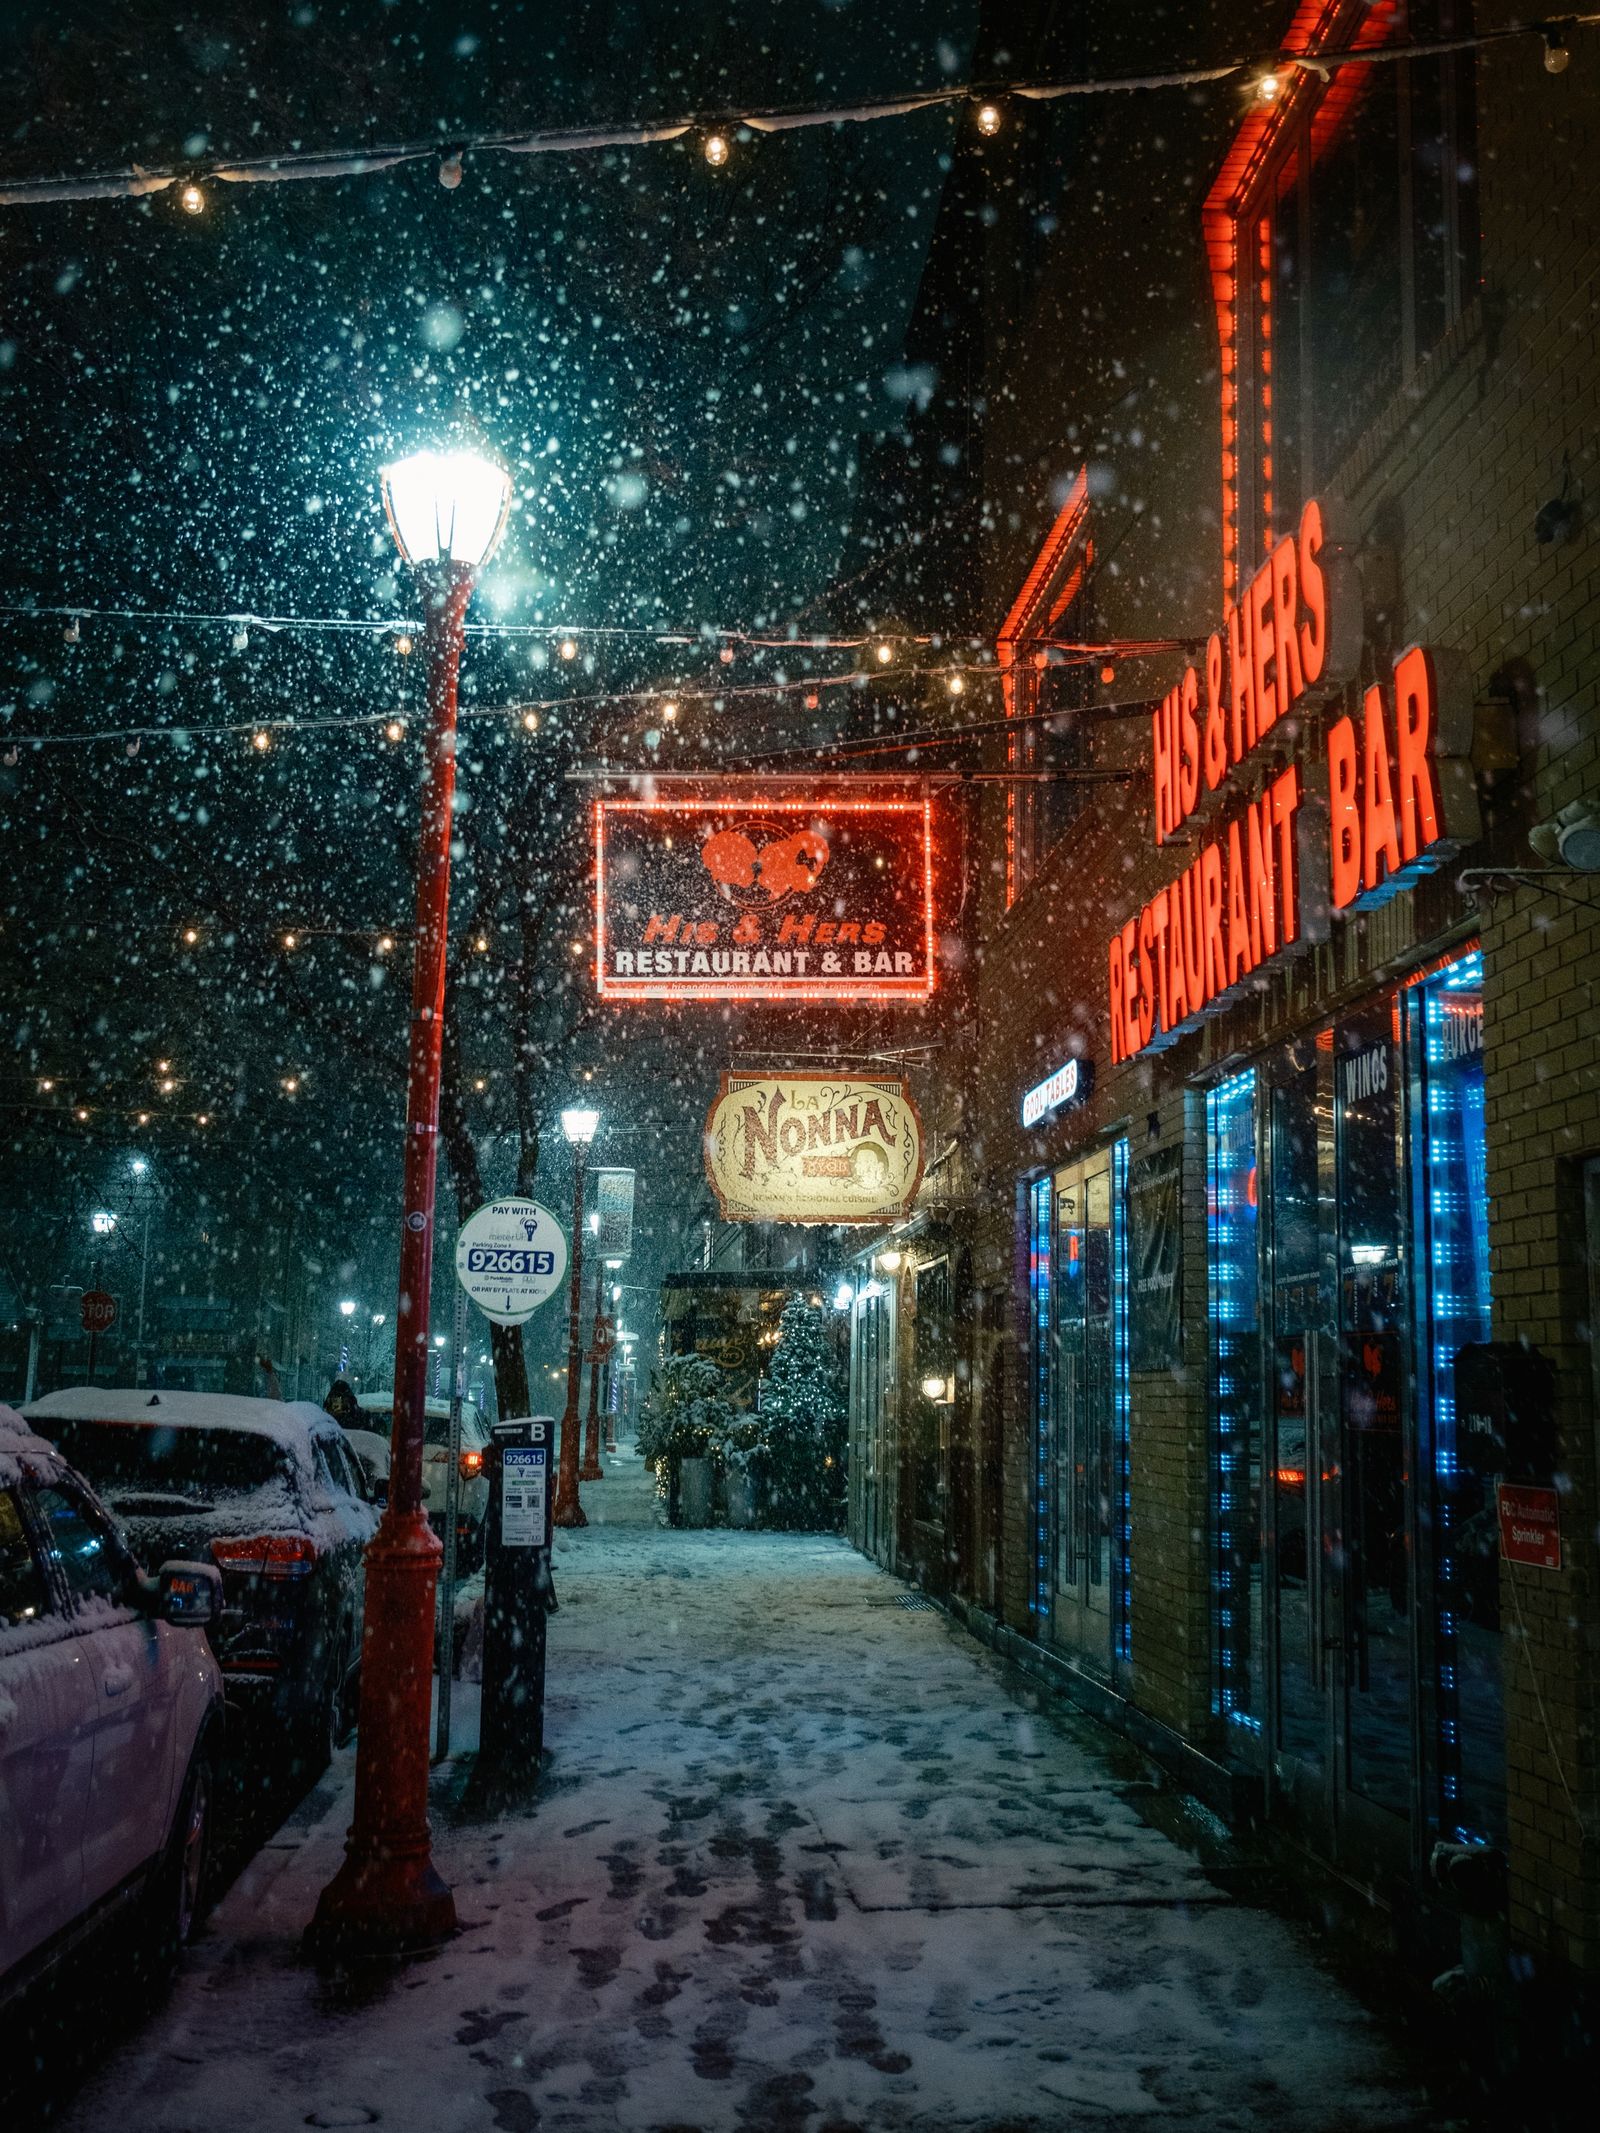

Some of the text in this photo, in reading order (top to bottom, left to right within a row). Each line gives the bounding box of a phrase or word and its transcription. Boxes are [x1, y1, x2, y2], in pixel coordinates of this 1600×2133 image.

[1153, 498, 1326, 846] HIS & HERS
[1109, 646, 1440, 1066] RESTAURANT BAR
[732, 915, 760, 944] &
[616, 951, 914, 973] RESTAURANT & BAR
[1046, 1066, 1075, 1103] TABLES
[1345, 1044, 1387, 1105] WINGS
[790, 1089, 819, 1111] LA
[741, 1085, 897, 1181] NONNA
[492, 1206, 537, 1216] PAY WITH
[471, 1251, 550, 1274] 926615
[531, 1423, 546, 1442] B
[506, 1454, 543, 1465] 926615
[1512, 1525, 1545, 1546] Sprinkler
